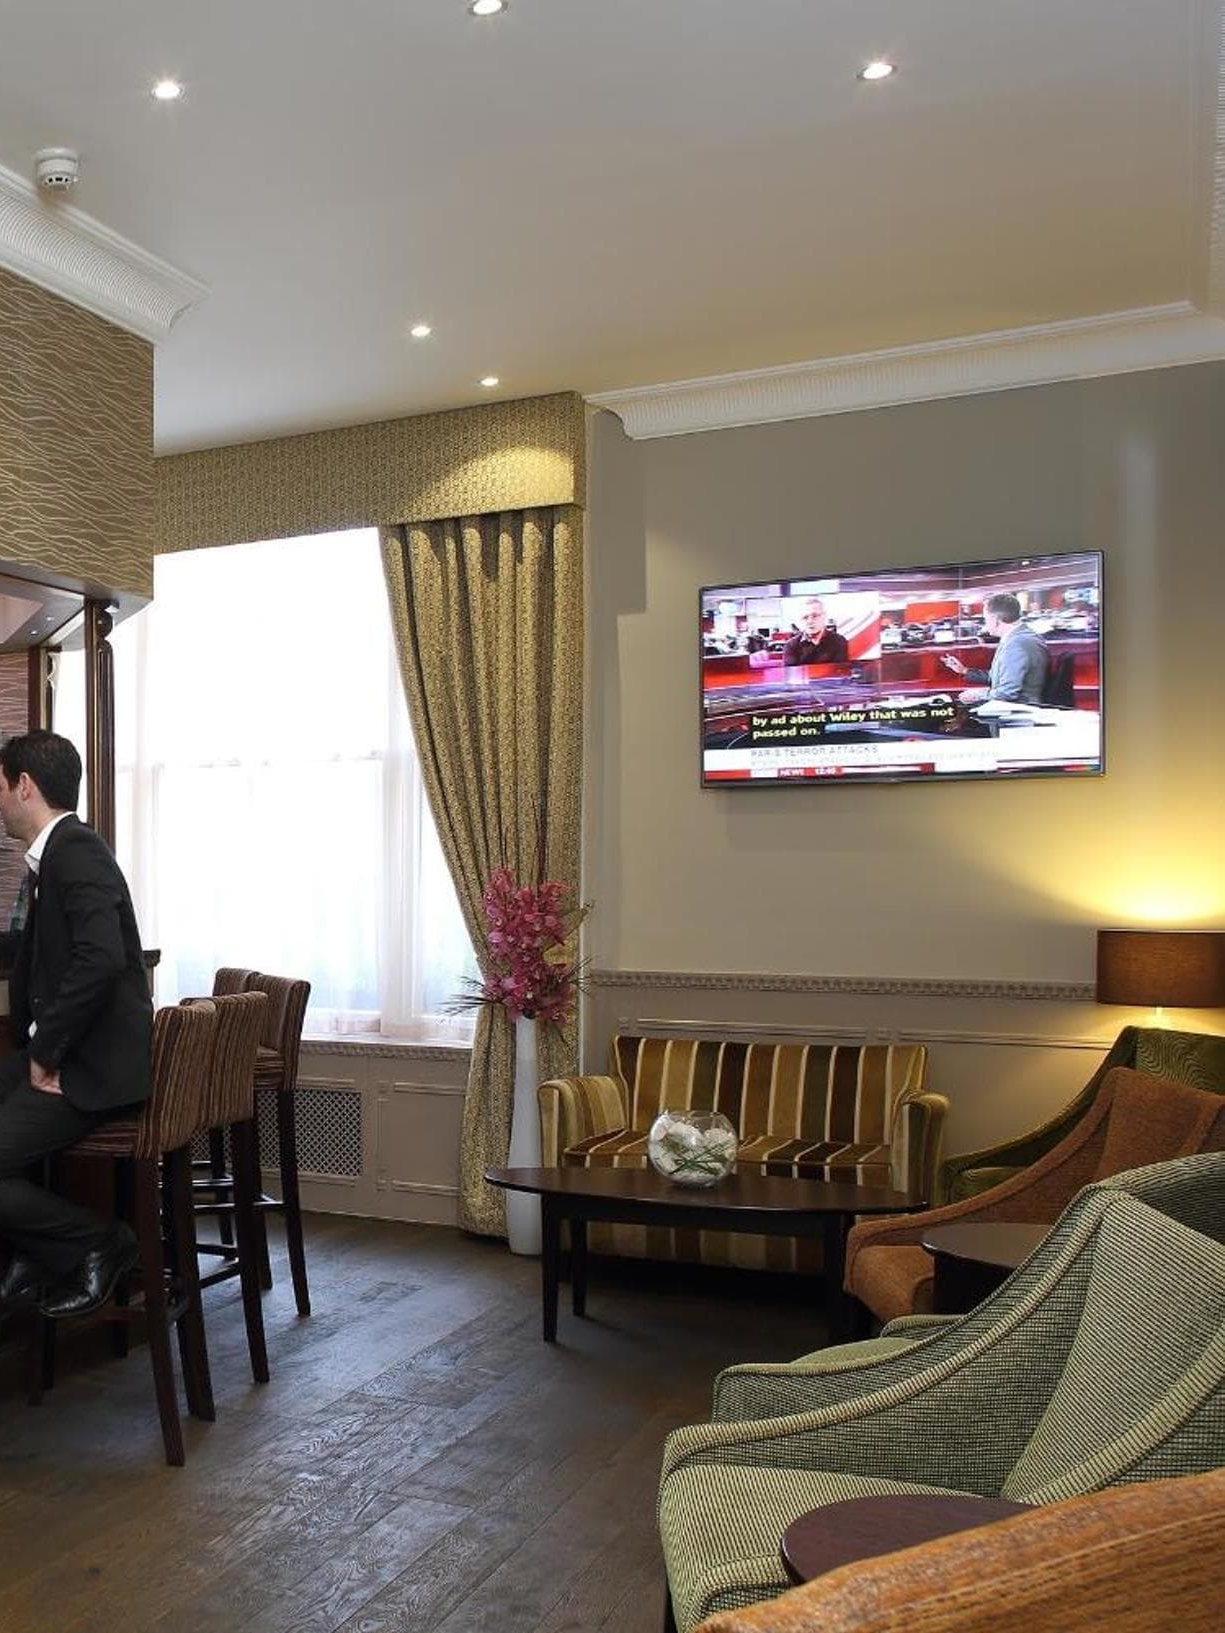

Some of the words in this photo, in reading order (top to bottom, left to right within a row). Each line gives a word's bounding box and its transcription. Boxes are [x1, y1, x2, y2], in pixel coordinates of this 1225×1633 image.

[752, 716, 767, 727] by
[770, 715, 786, 725] ad
[790, 713, 826, 724] about
[829, 711, 866, 722] Wiley
[870, 709, 897, 719] that
[901, 709, 927, 718] was
[931, 707, 955, 717] not
[752, 726, 797, 739] passed
[800, 728, 821, 736] on.
[784, 747, 825, 756] TERROR
